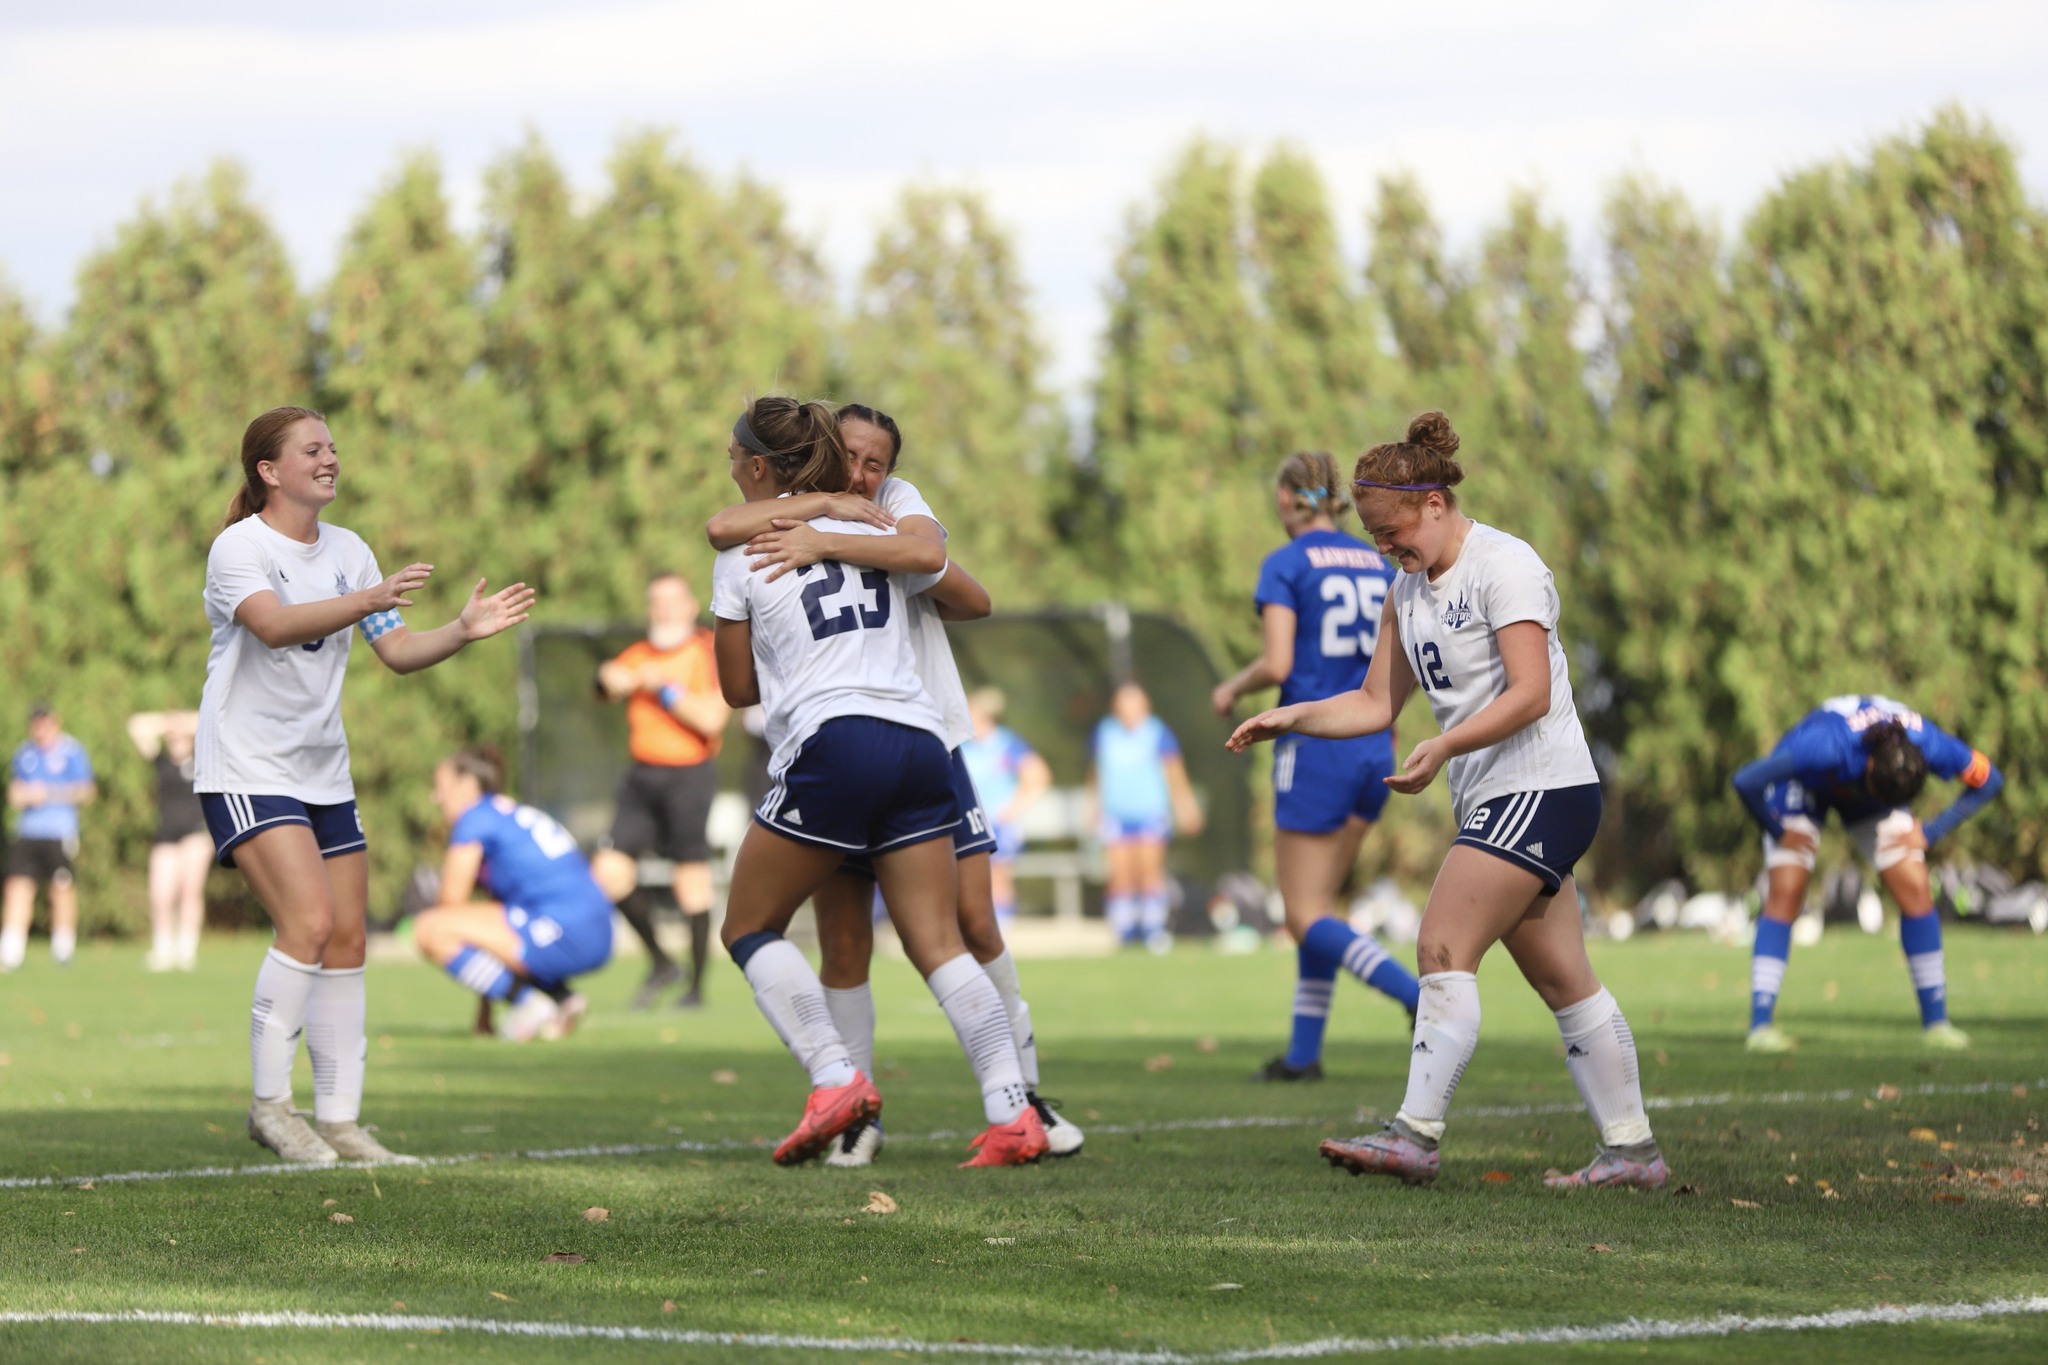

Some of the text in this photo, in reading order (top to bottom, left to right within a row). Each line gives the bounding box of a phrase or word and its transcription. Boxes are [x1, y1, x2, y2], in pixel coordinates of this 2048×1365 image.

[797, 560, 891, 641] 23
[1320, 574, 1388, 657] 25
[1441, 611, 1472, 625] TRITONS
[1414, 641, 1453, 691] 12
[1464, 807, 1491, 830] 12
